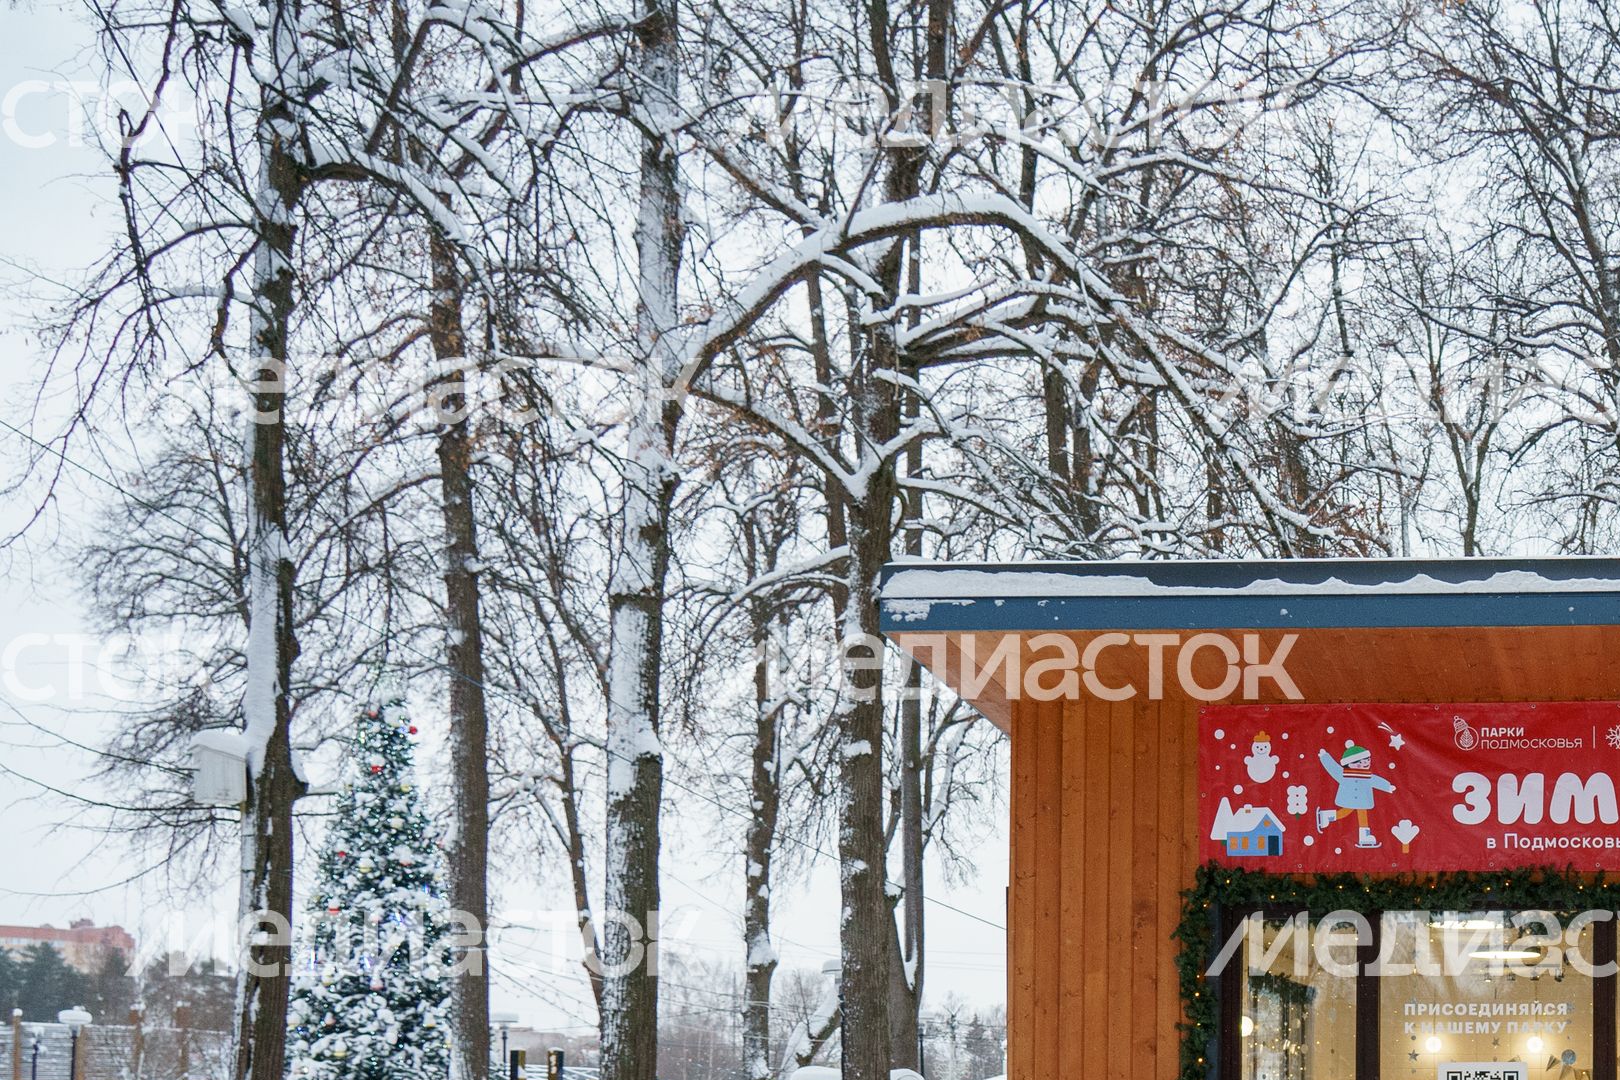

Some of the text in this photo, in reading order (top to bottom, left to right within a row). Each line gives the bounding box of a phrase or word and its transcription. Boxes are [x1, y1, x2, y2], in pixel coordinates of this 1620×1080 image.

[1481, 727, 1525, 737] ПАРКИ
[1481, 738, 1583, 750] ПОДМОСКОВЬЯ
[1487, 836, 1497, 849] в
[1404, 1001, 1568, 1017] ПРИСОЕДИНЯЙСЯ
[1404, 1022, 1567, 1034] К НАШЕМУ ПАРКУ
